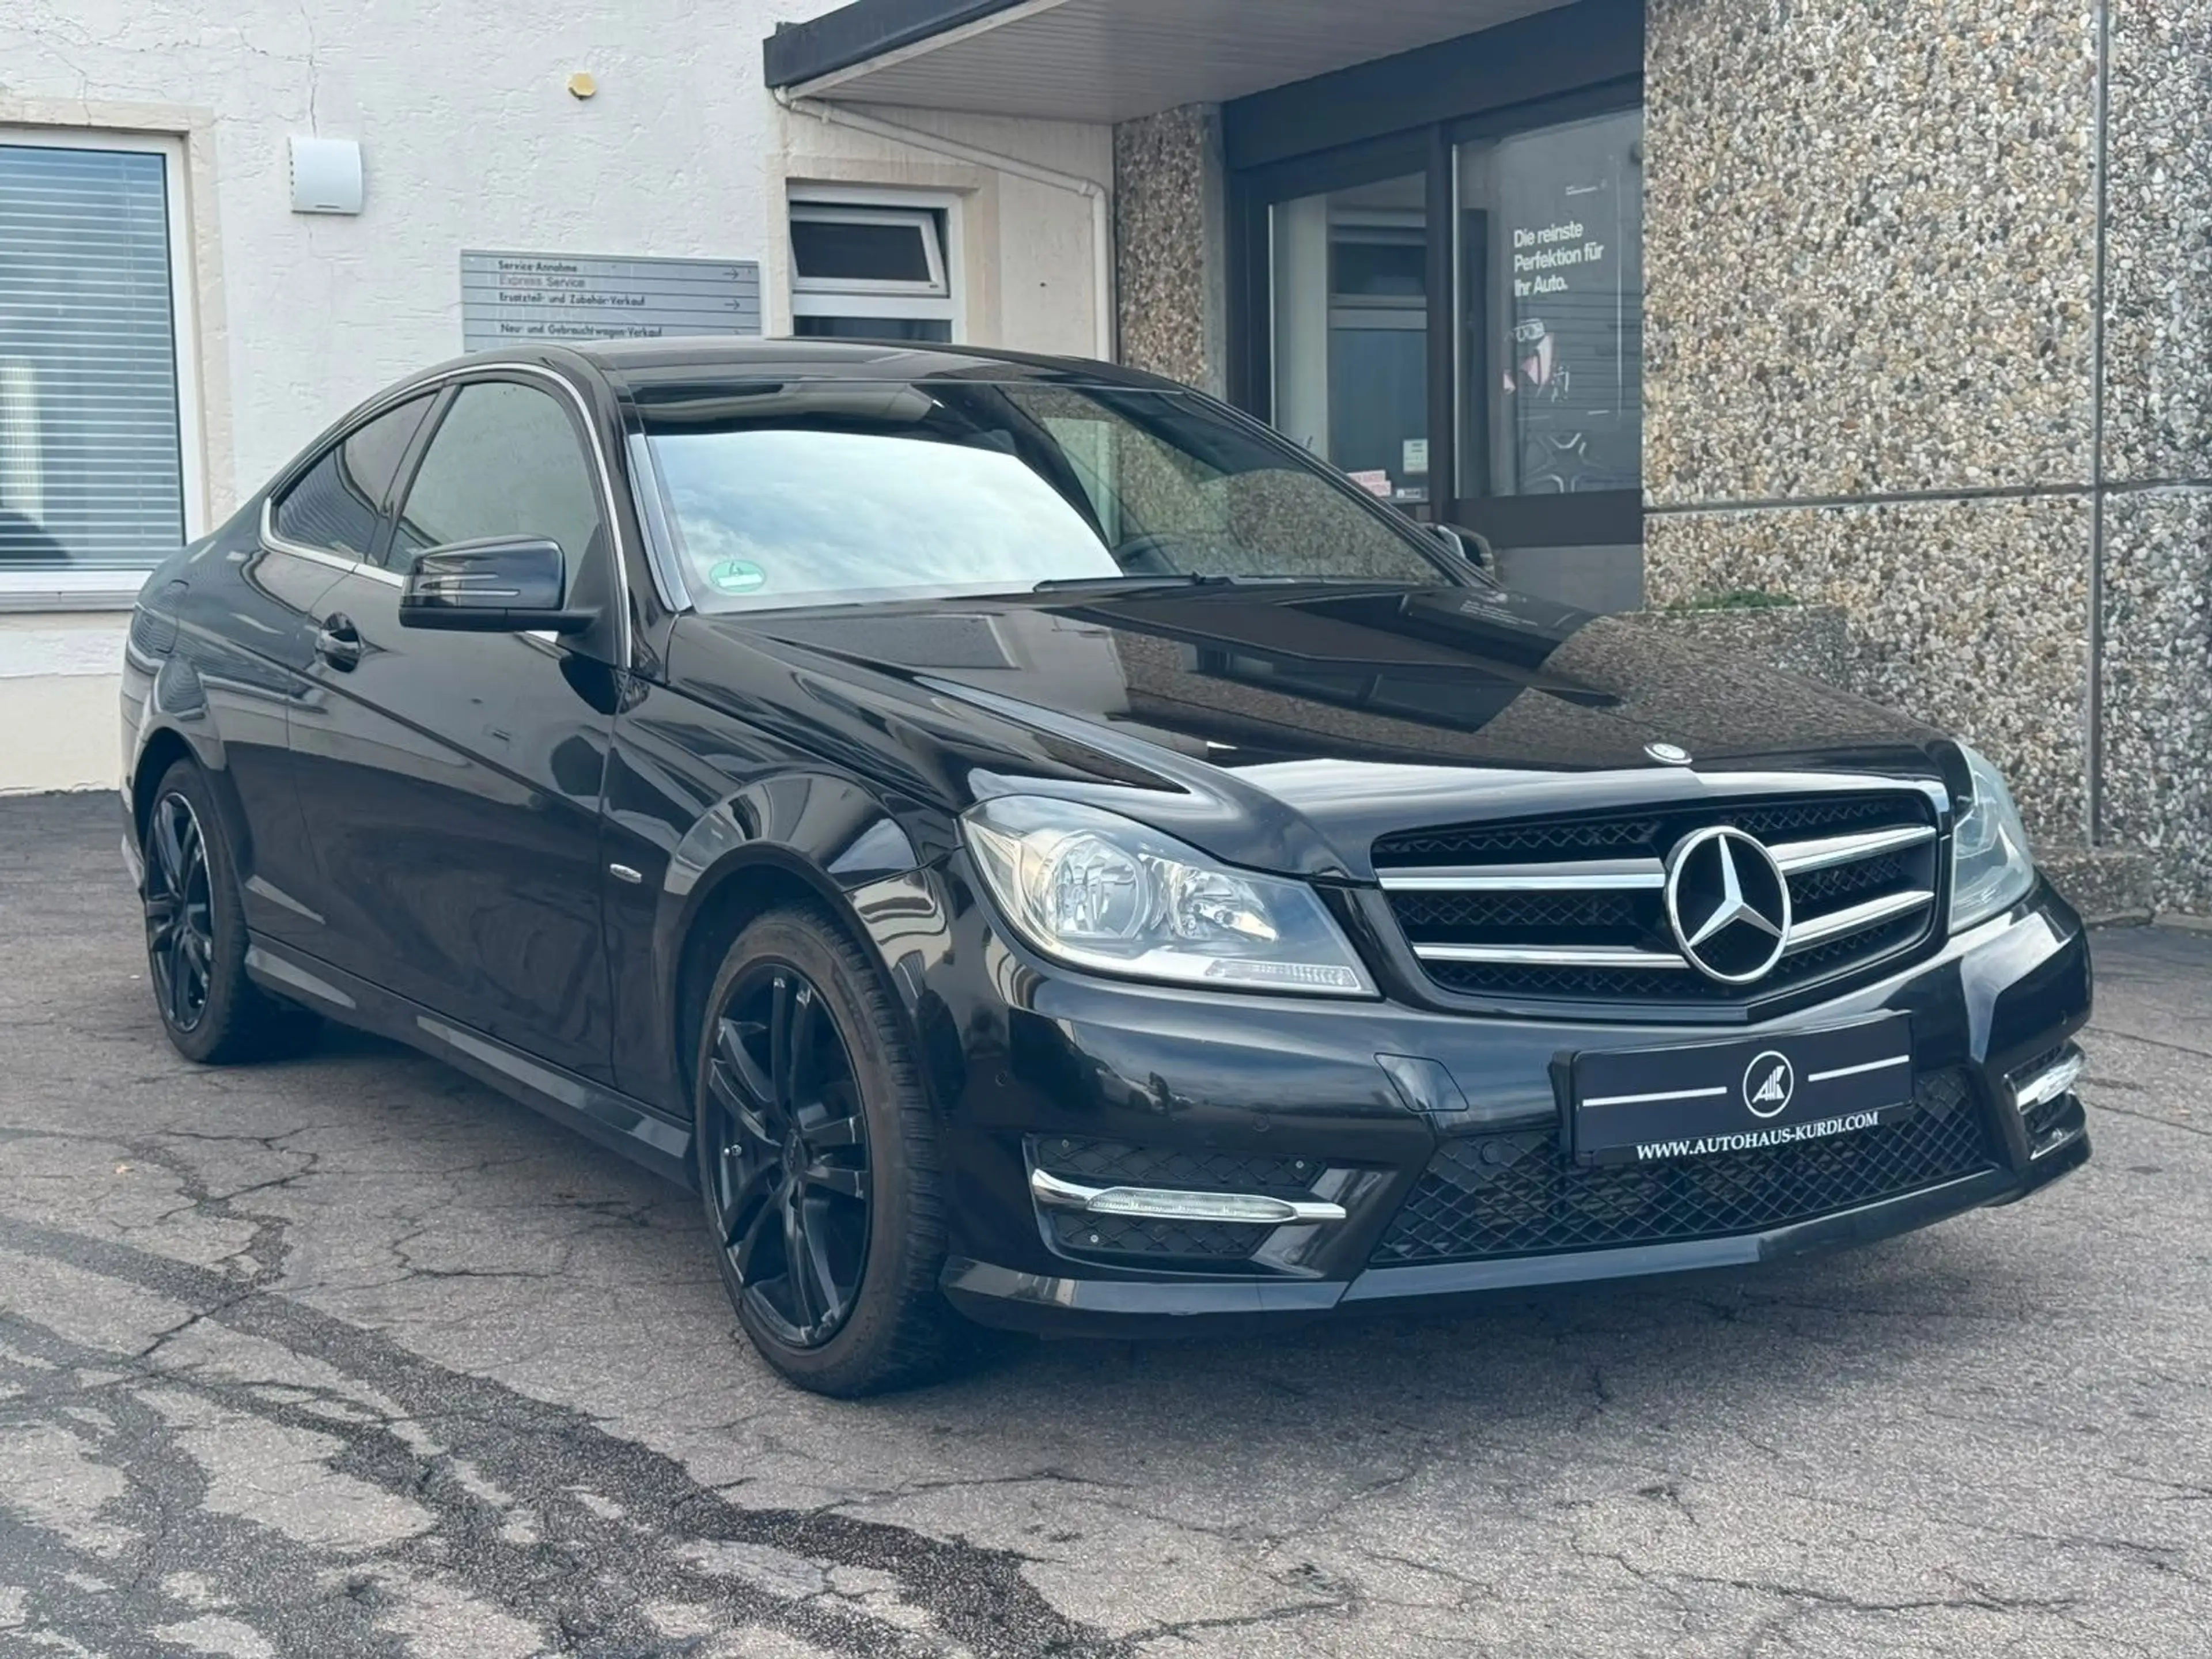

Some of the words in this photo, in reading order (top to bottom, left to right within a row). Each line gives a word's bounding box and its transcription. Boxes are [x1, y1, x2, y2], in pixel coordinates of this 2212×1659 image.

[1514, 229, 1535, 248] Die
[1537, 221, 1584, 244] reinste
[1514, 247, 1582, 273] Perfektion
[1584, 242, 1605, 262] für
[546, 276, 585, 287] Service
[1514, 279, 1532, 297] Ihr
[1533, 274, 1569, 295] Auto.
[549, 292, 565, 304] und
[527, 324, 544, 334] und
[1637, 1111, 1879, 1161] WWW.AUTOHAUS-KURDI.COM
